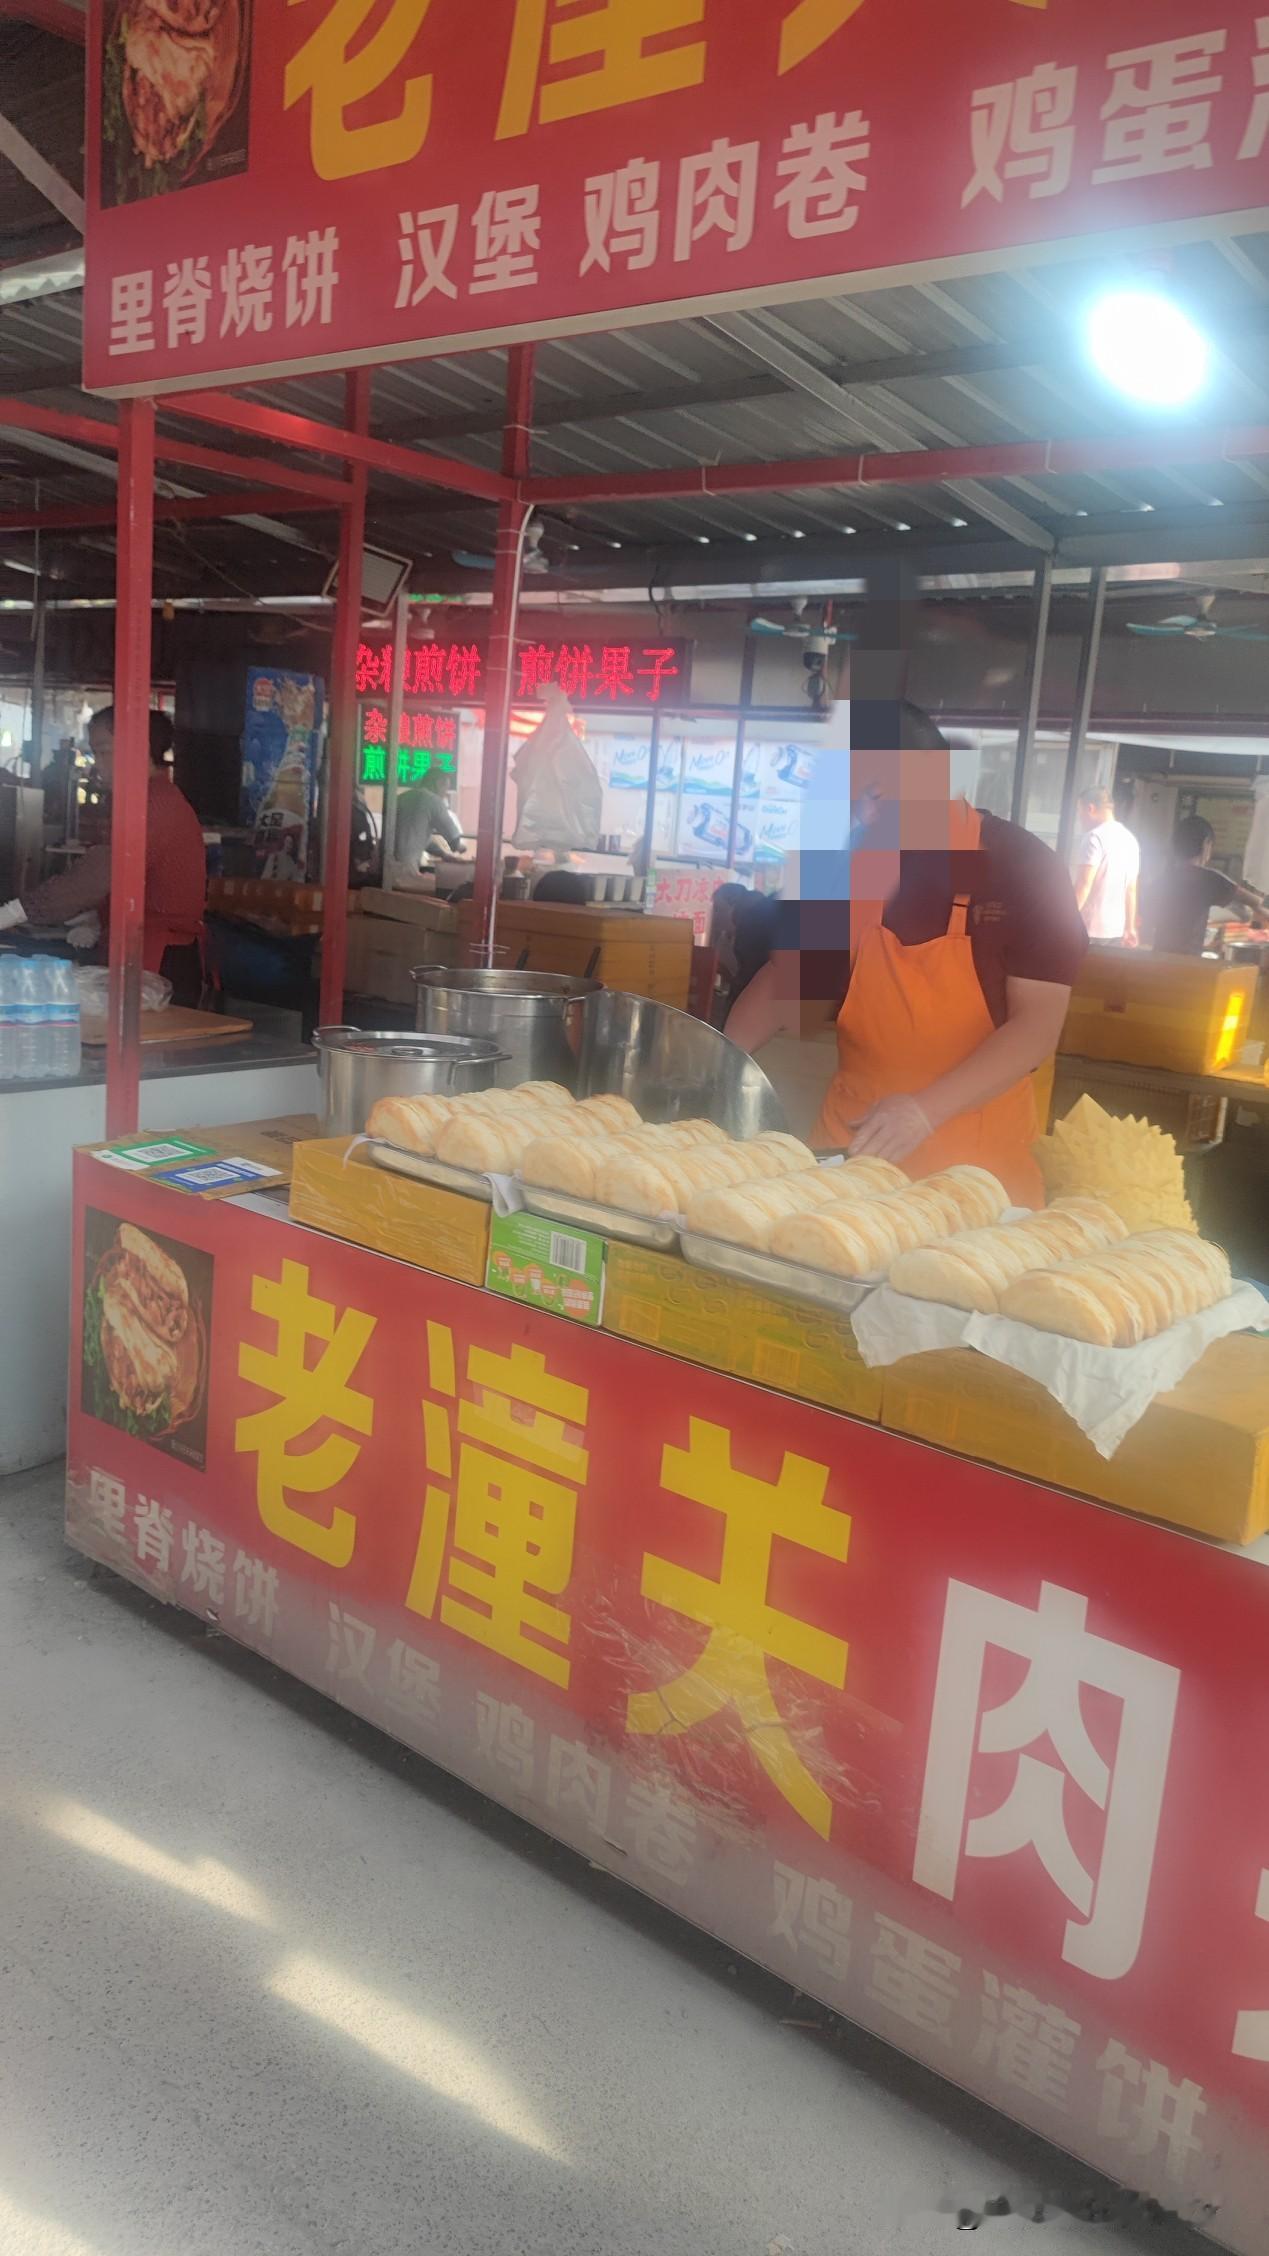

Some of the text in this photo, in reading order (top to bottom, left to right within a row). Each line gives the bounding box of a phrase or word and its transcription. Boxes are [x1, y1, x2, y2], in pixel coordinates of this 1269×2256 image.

[108, 226, 340, 356] 里脊烧饼
[394, 184, 541, 309] 汉堡
[578, 109, 871, 279] 鸡肉卷
[516, 644, 679, 701] 煎饼果子
[89, 1468, 1208, 2184] 里脊烧饼 汉堡 鸡肉卷 鸡蛋灌饼
